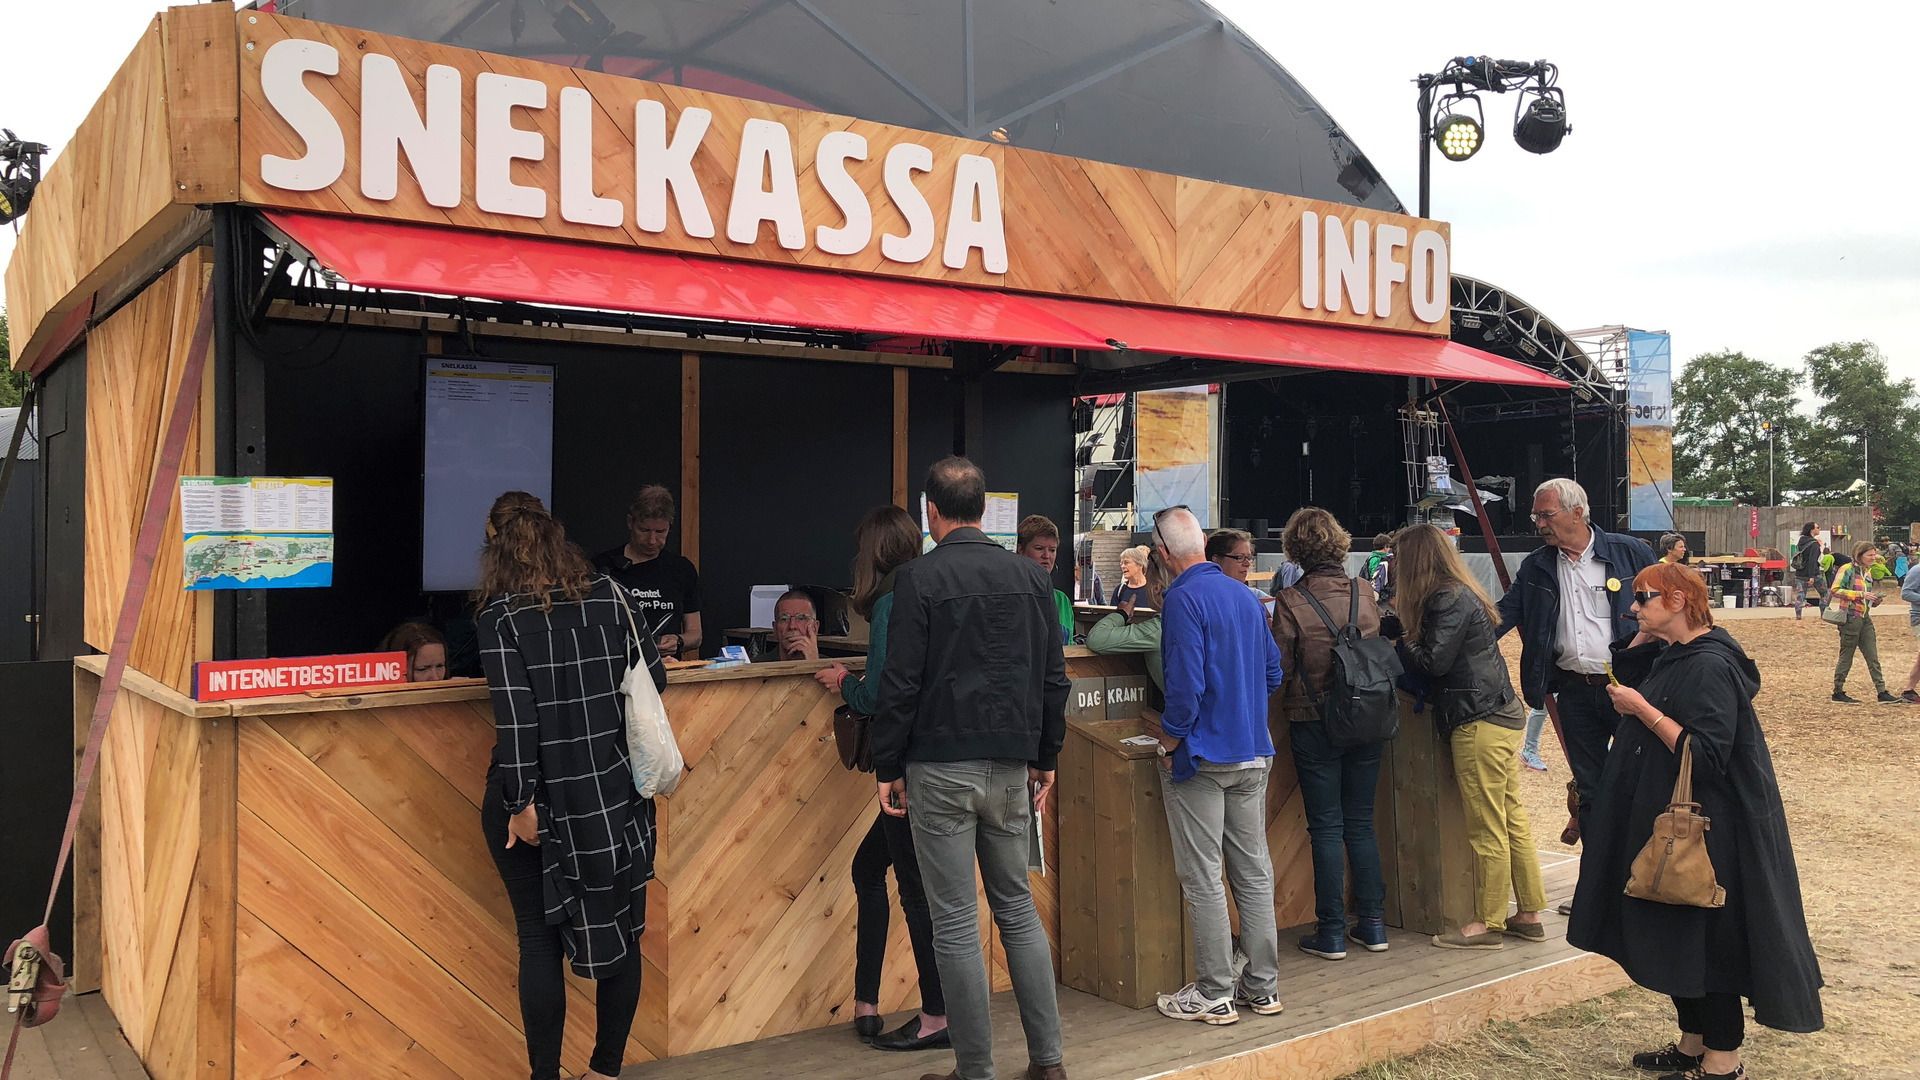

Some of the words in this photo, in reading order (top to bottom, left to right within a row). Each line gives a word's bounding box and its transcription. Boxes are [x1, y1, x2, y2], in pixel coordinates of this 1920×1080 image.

[260, 38, 1008, 274] SNELKASSA
[1301, 210, 1449, 323] INFO
[441, 362, 477, 370] SNELKASSA
[631, 588, 661, 598] Pentel
[653, 600, 674, 610] Pen
[209, 661, 401, 692] INTERNETBESTELLING
[1078, 690, 1102, 708] DAG
[1107, 687, 1145, 705] KRANT
